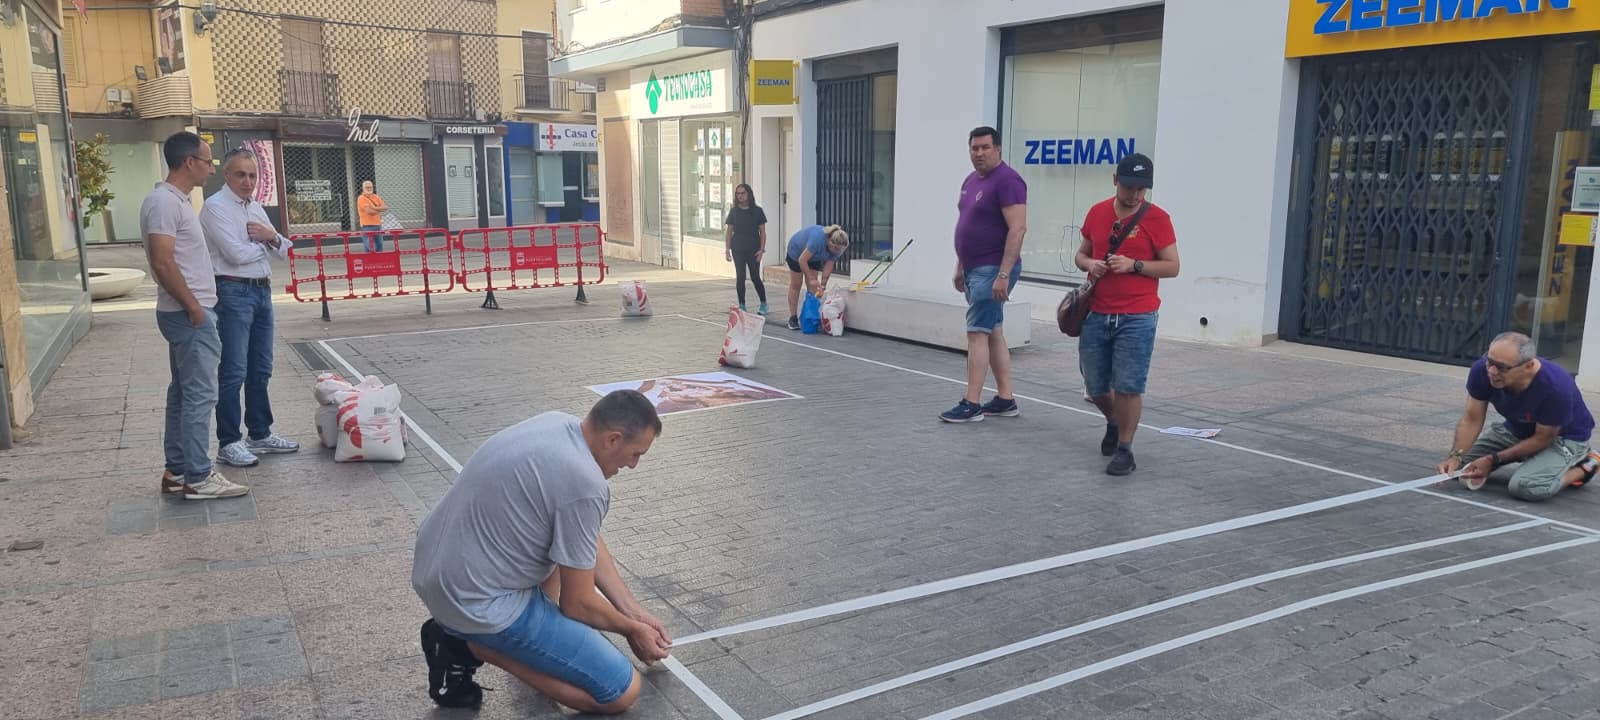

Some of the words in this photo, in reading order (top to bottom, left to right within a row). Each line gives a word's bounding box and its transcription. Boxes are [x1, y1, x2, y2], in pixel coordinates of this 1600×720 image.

[1313, 0, 1572, 34] ZEEM
[663, 69, 712, 102] TECNOCASA
[346, 107, 379, 142] Meli
[564, 128, 587, 138] Casa
[1024, 138, 1135, 165] ZEEMAN
[1549, 159, 1581, 297] ZEAN
